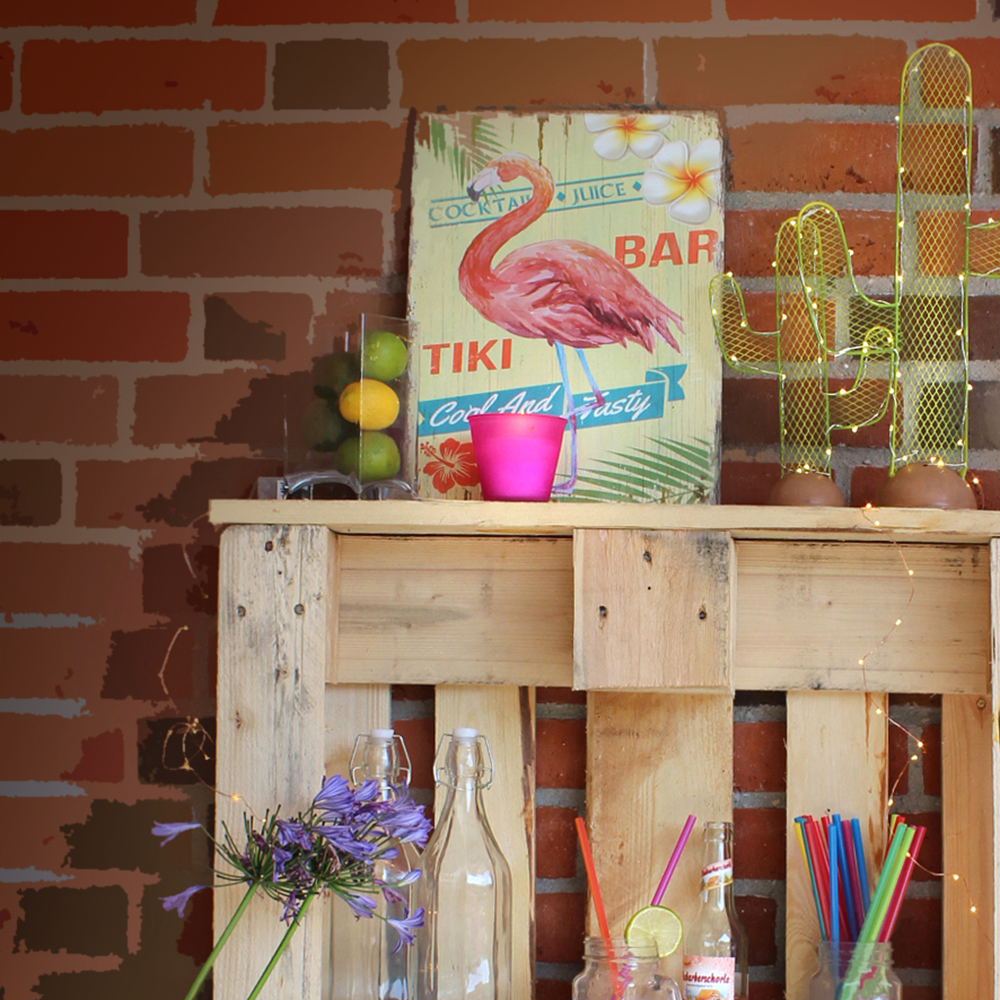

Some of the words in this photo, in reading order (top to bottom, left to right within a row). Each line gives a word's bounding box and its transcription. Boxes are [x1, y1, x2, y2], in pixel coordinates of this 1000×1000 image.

[572, 181, 627, 206] JUICE
[613, 229, 719, 270] BAR
[422, 338, 513, 375] TIKI
[429, 393, 499, 427] Cool
[497, 385, 562, 414] And
[579, 388, 651, 420] Tasty
